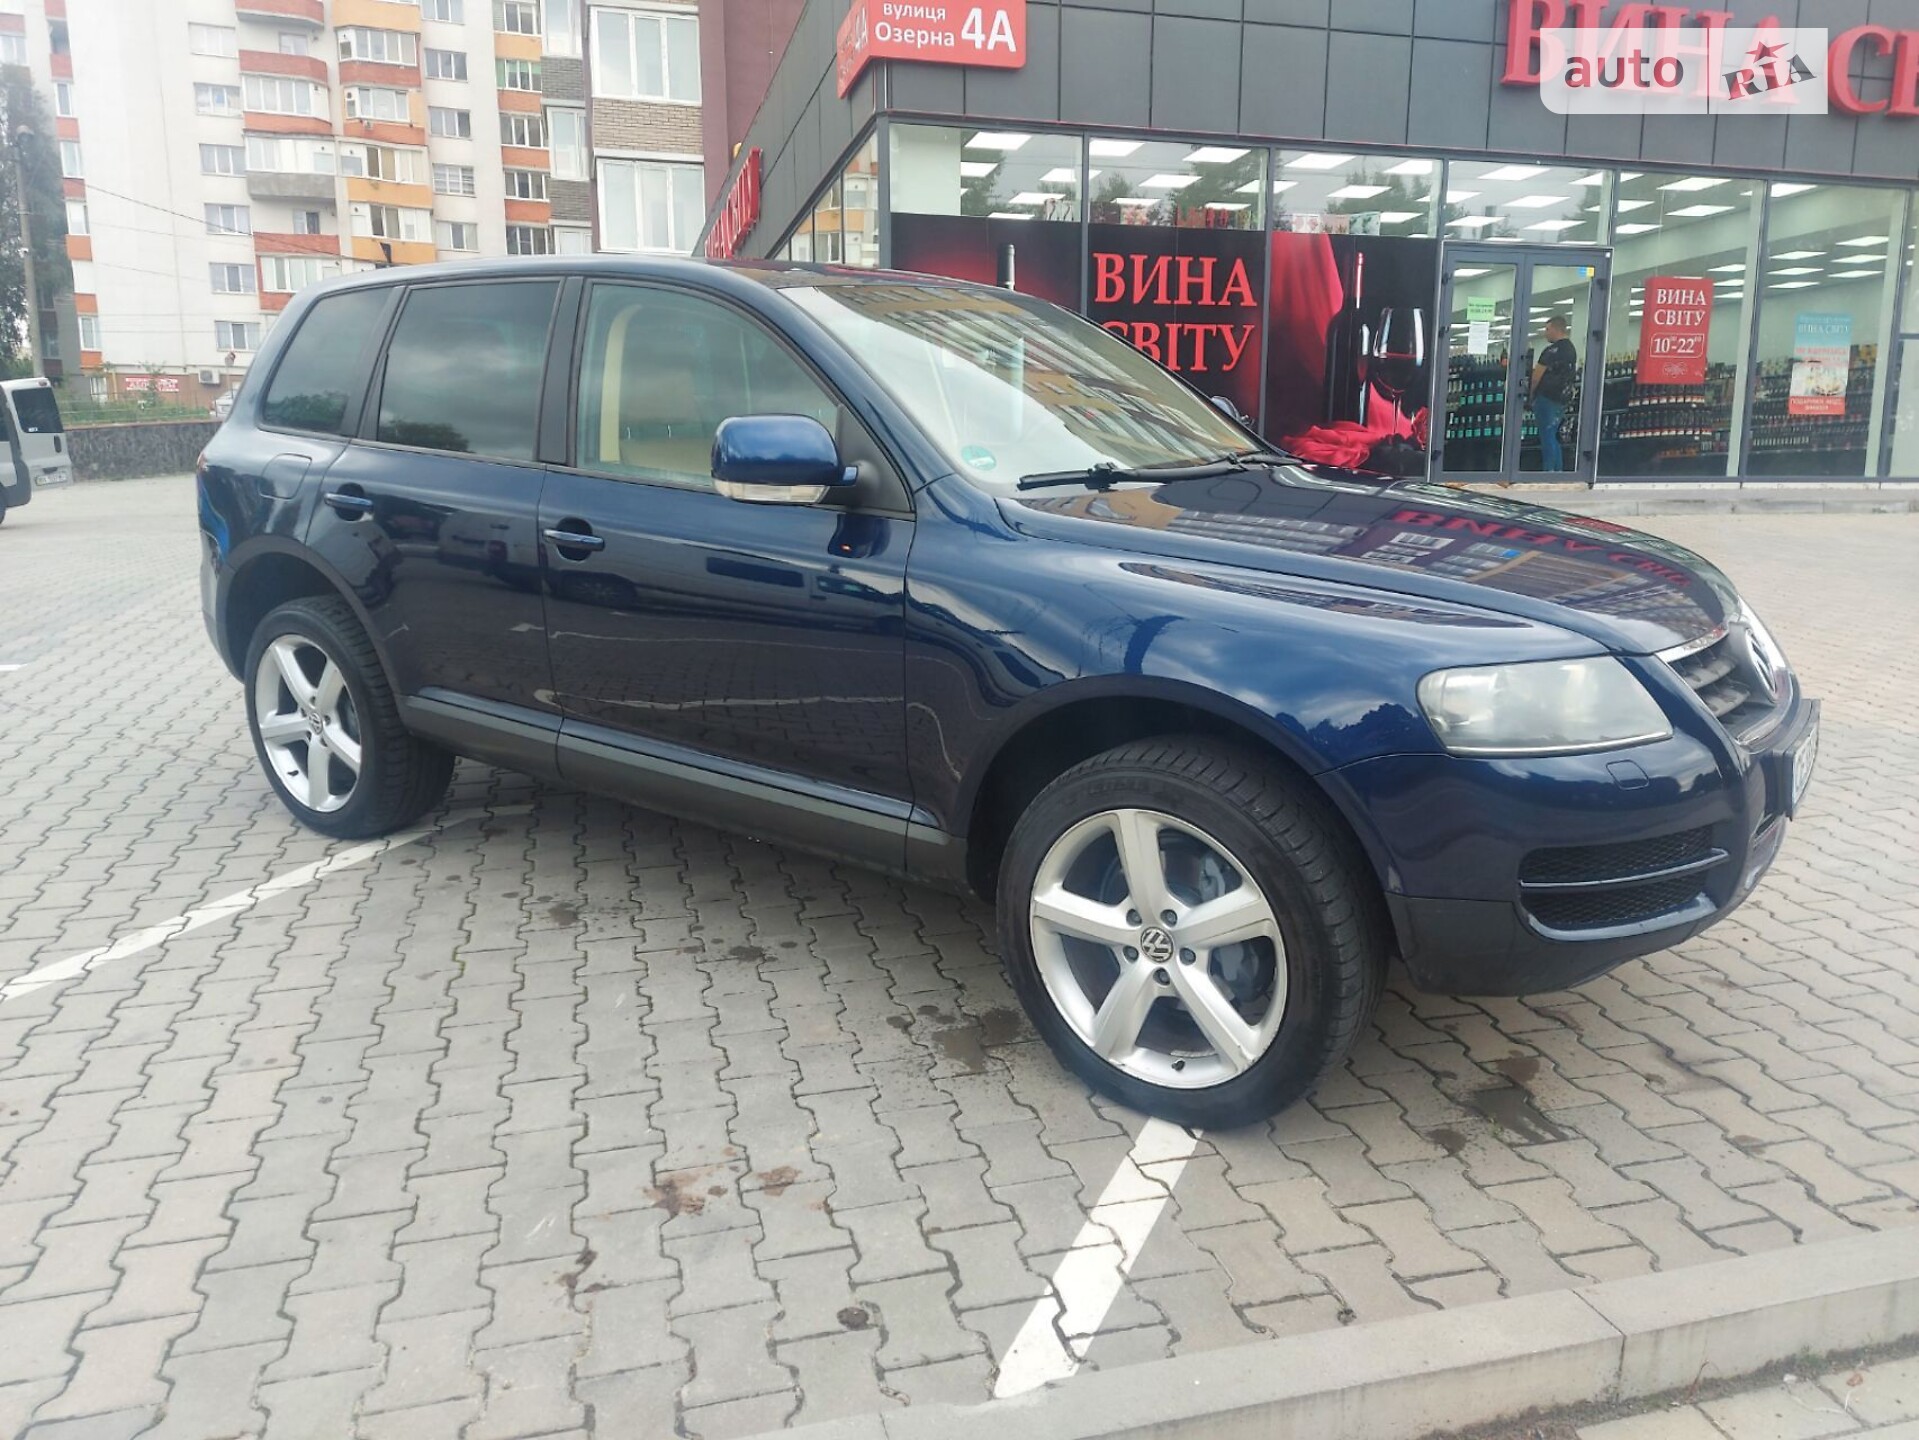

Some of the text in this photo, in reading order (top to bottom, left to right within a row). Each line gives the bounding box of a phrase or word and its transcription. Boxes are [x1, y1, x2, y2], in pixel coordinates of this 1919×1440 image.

[883, 2, 946, 22] вулиця
[874, 21, 955, 48] Озерна
[960, 7, 1017, 53] 4А
[1092, 252, 1258, 307] ВИНА
[1656, 288, 1707, 306] ВИНА
[1653, 309, 1706, 326] СВІТУ
[1100, 320, 1256, 372] ВІТУ
